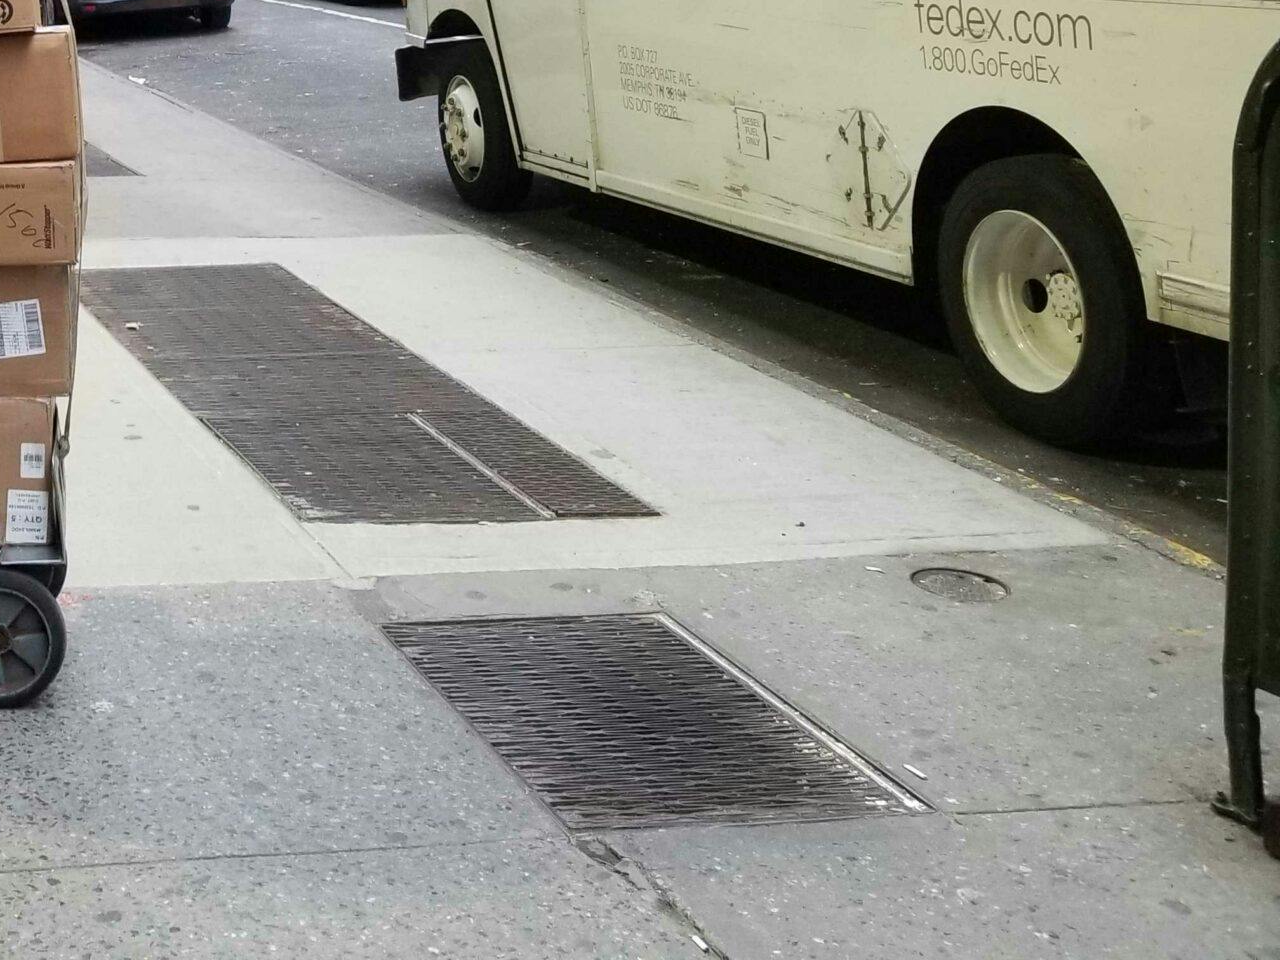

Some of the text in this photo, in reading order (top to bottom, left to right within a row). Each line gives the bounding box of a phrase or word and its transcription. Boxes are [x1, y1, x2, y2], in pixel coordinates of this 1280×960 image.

[631, 46, 645, 62] BOX
[635, 63, 677, 85] CORPORATE
[919, 45, 1062, 86] 1.800.GoFedEx
[622, 95, 635, 111] US
[636, 97, 652, 114] DOT
